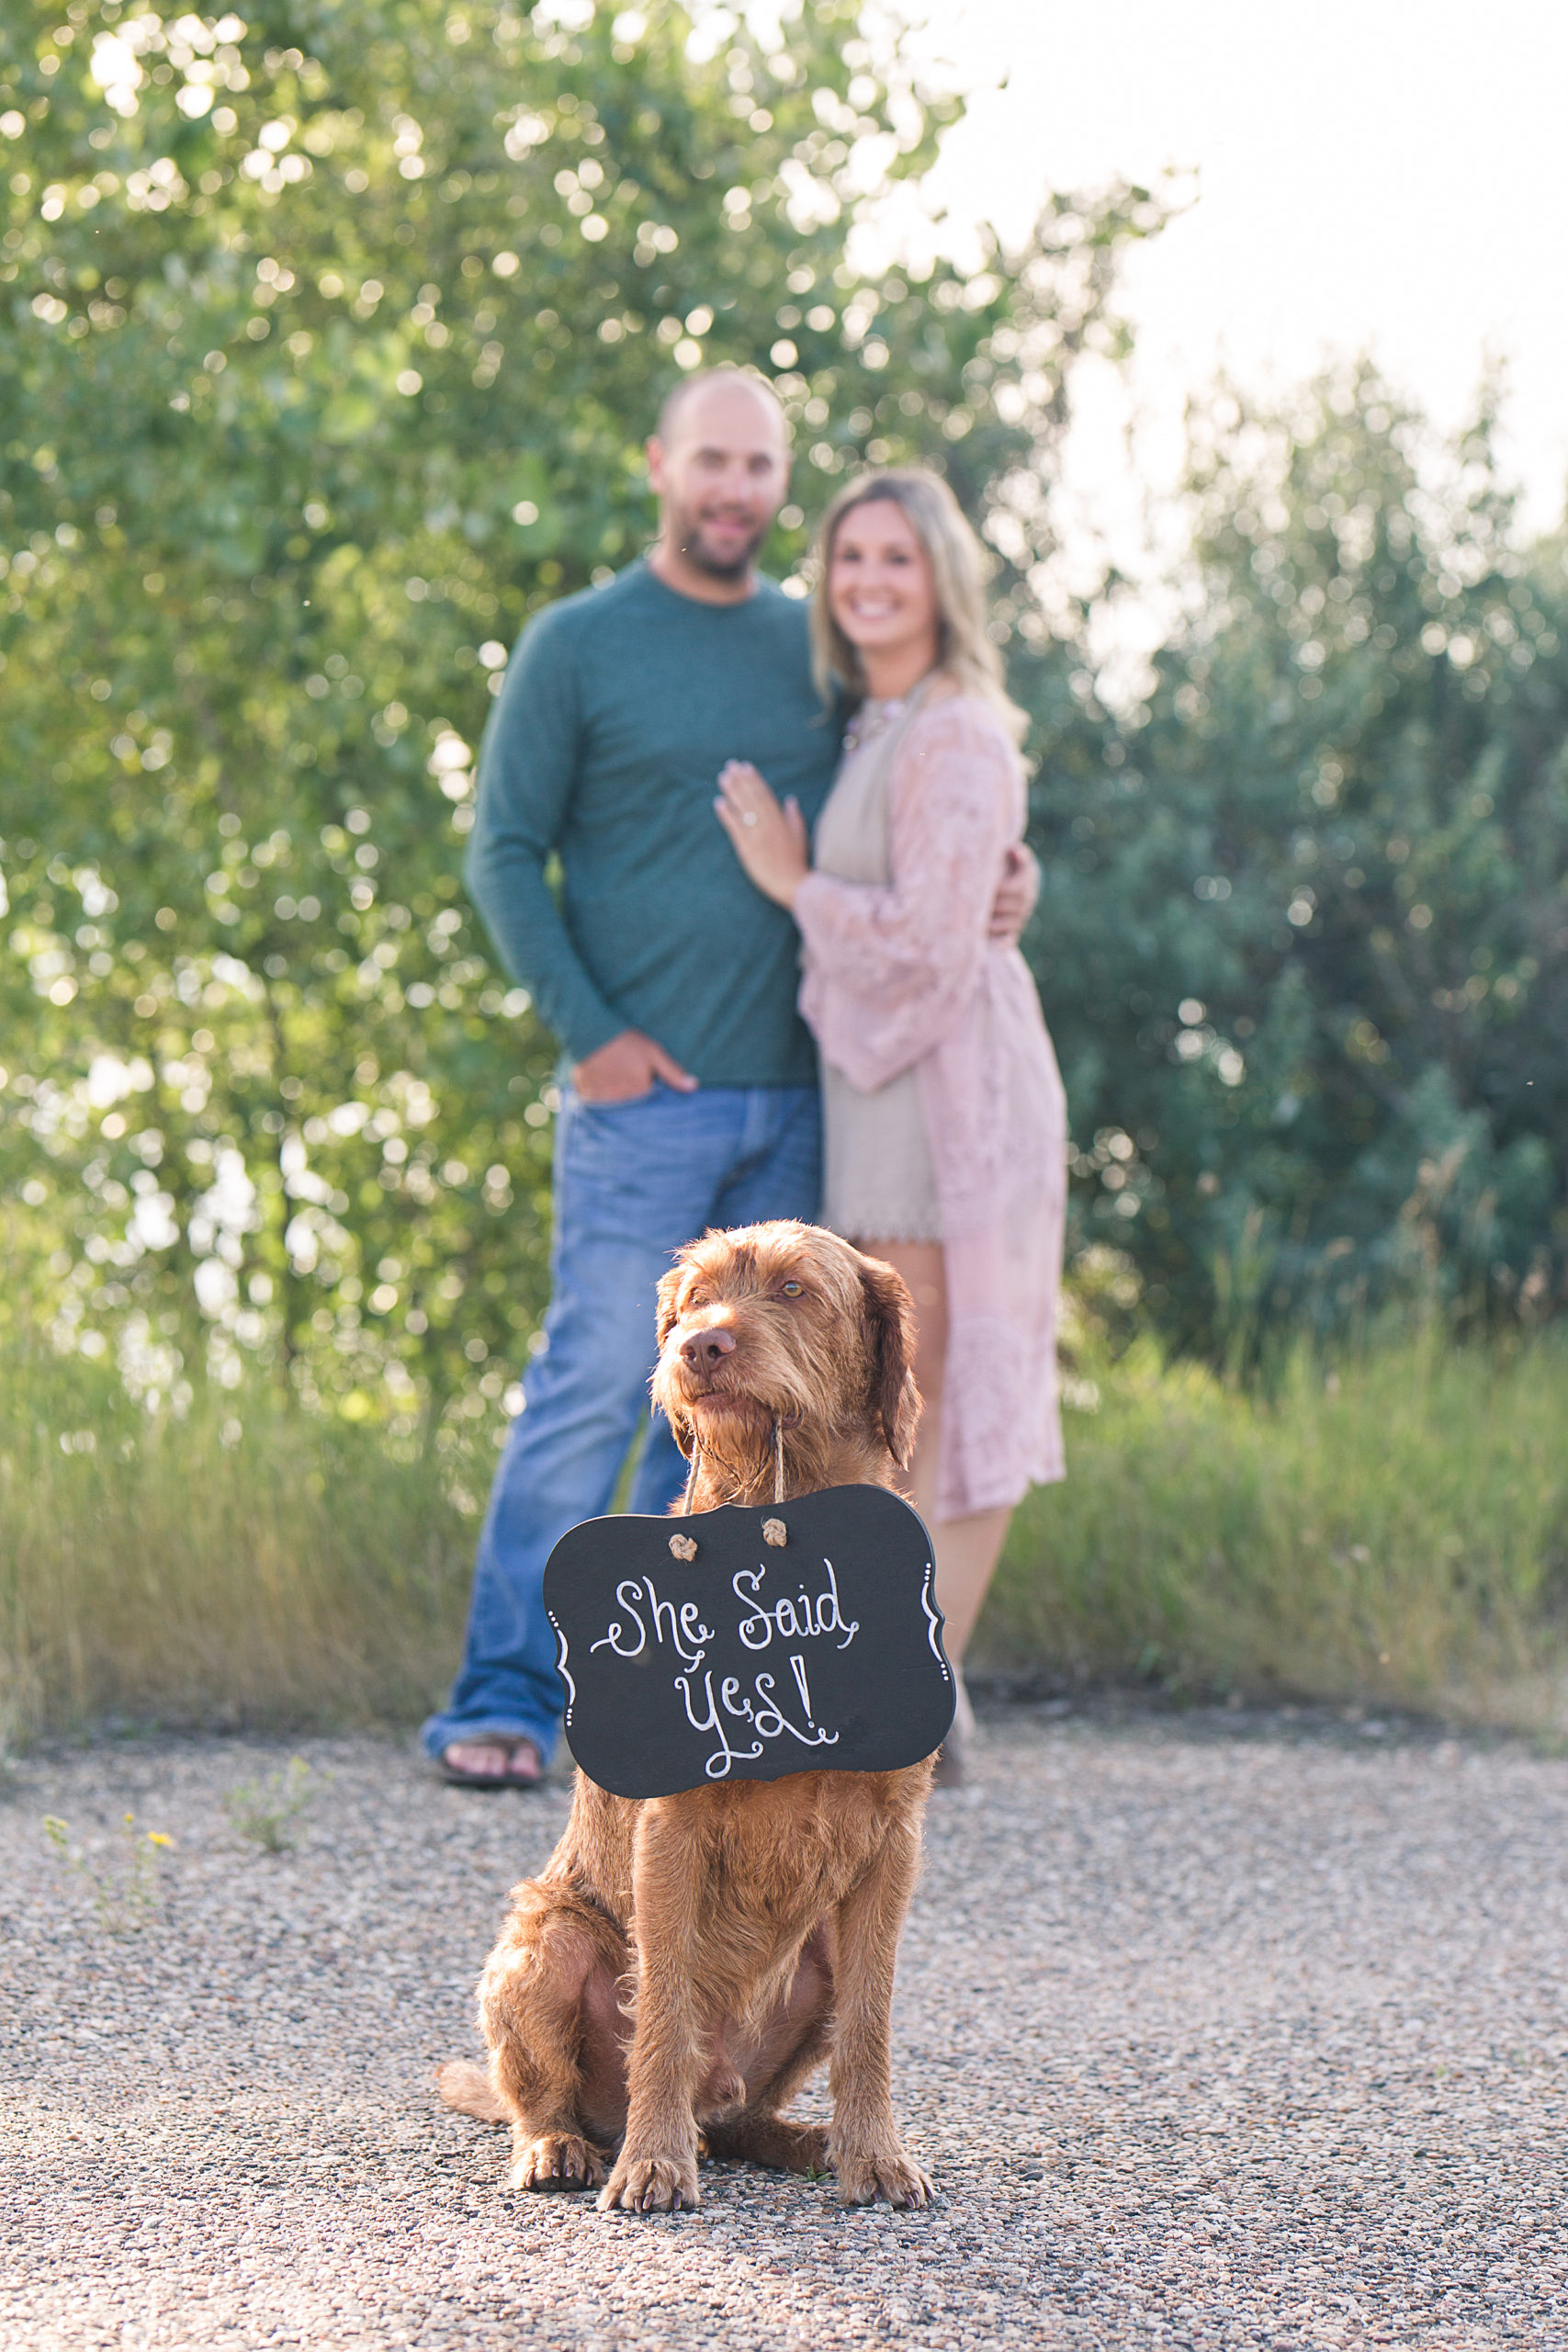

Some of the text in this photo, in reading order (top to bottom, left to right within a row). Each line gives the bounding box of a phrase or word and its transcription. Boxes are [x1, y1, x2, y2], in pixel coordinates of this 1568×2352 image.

[591, 1557, 860, 1673] She Said
[673, 1655, 840, 1780] Yes!
